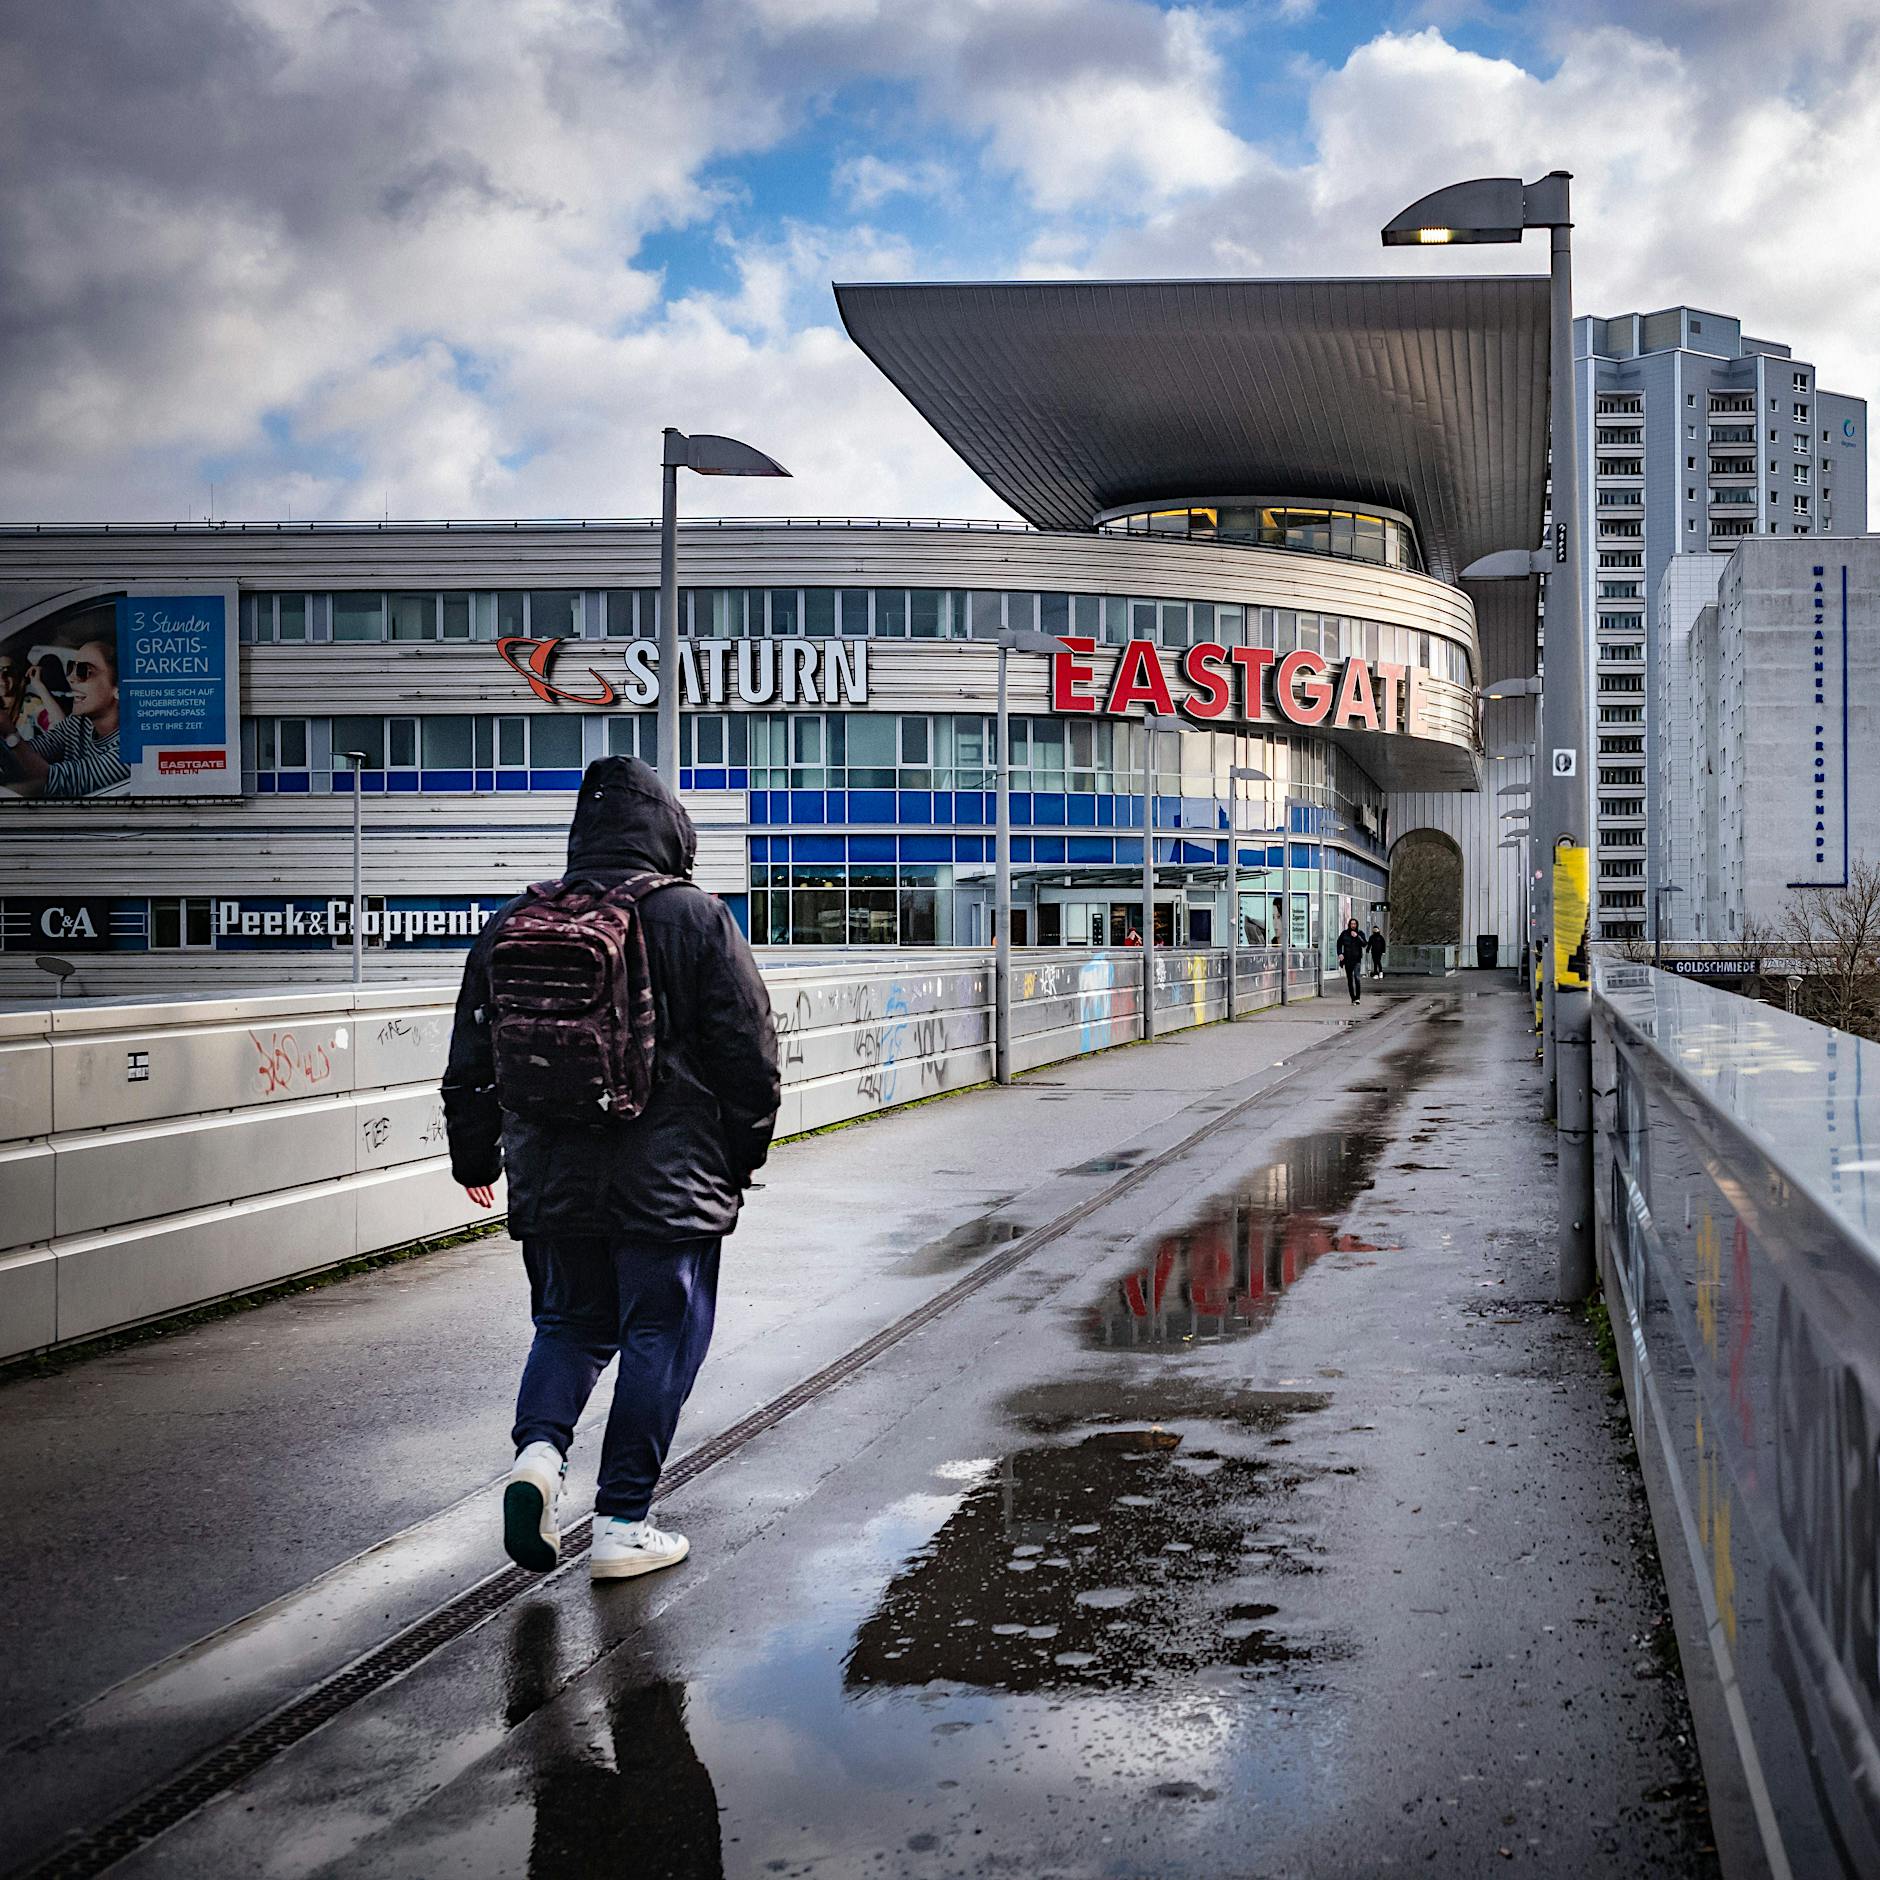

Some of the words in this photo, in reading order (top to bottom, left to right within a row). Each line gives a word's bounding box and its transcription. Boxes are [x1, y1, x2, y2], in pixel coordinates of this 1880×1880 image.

[131, 612, 145, 631] 3
[149, 611, 210, 633] Stunden
[136, 637, 208, 654] GRATIS-
[135, 657, 209, 674] PARKEN
[623, 639, 868, 705] SATURN
[129, 689, 162, 697] FREUEN
[164, 689, 175, 697] SIE
[177, 688, 196, 696] SICH
[198, 688, 215, 696] AUF
[1053, 637, 1429, 734] EASTGATE
[139, 699, 206, 707] UNGEBREMSTEN
[153, 722, 164, 730] IST
[166, 722, 183, 730] IHRE
[160, 760, 225, 769] EASTGATE
[1814, 725, 1824, 863] PROMENADE
[40, 907, 98, 938] C&A
[1676, 961, 1756, 973] GOLDSCHMIEDE
